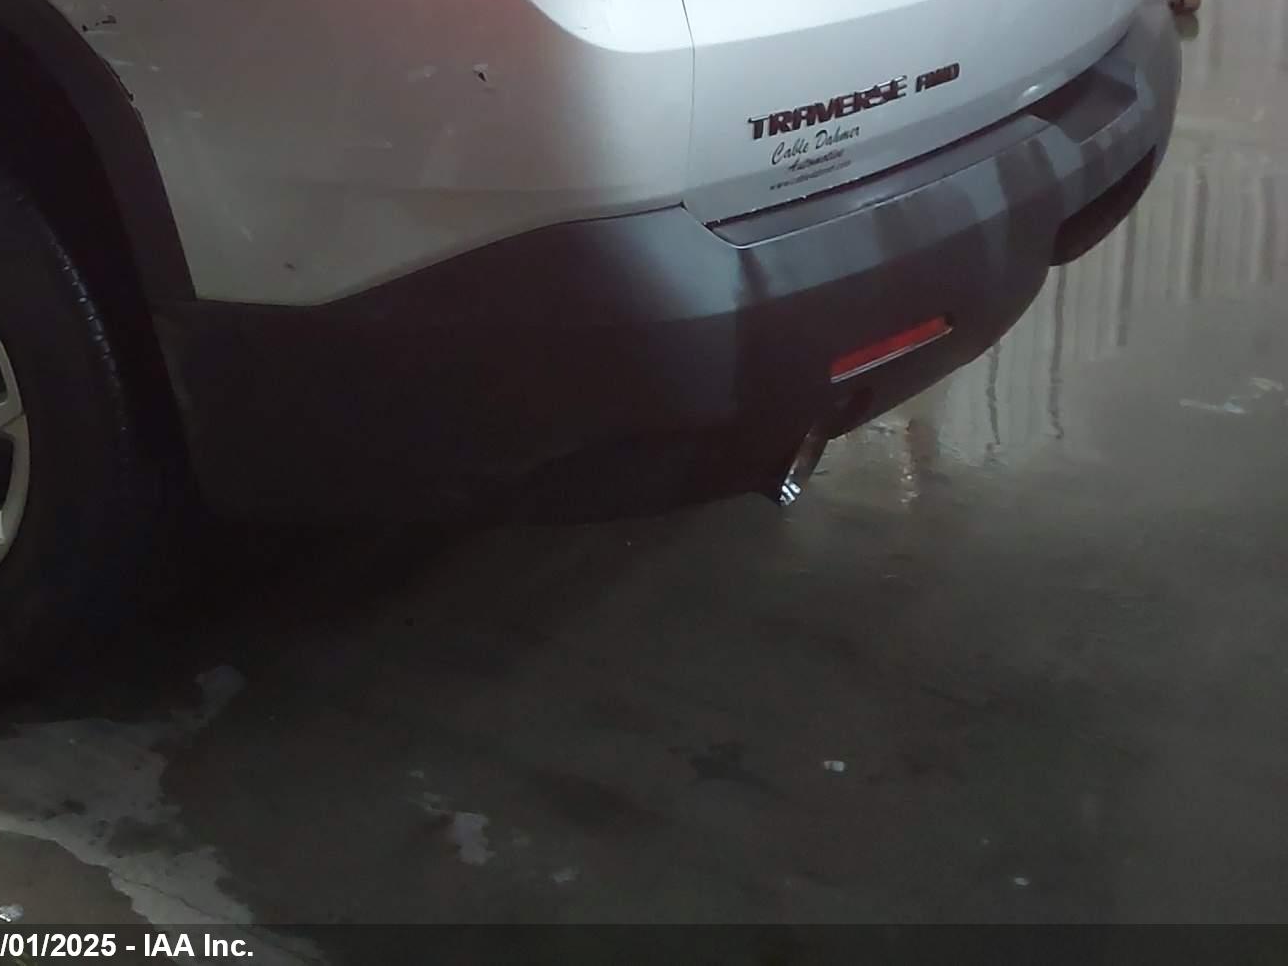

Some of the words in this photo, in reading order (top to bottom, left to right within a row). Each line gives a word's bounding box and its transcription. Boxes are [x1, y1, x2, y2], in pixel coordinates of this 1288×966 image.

[748, 75, 907, 140] TRAVERSE
[771, 138, 809, 165] Cable
[815, 125, 860, 150] Dahmer
